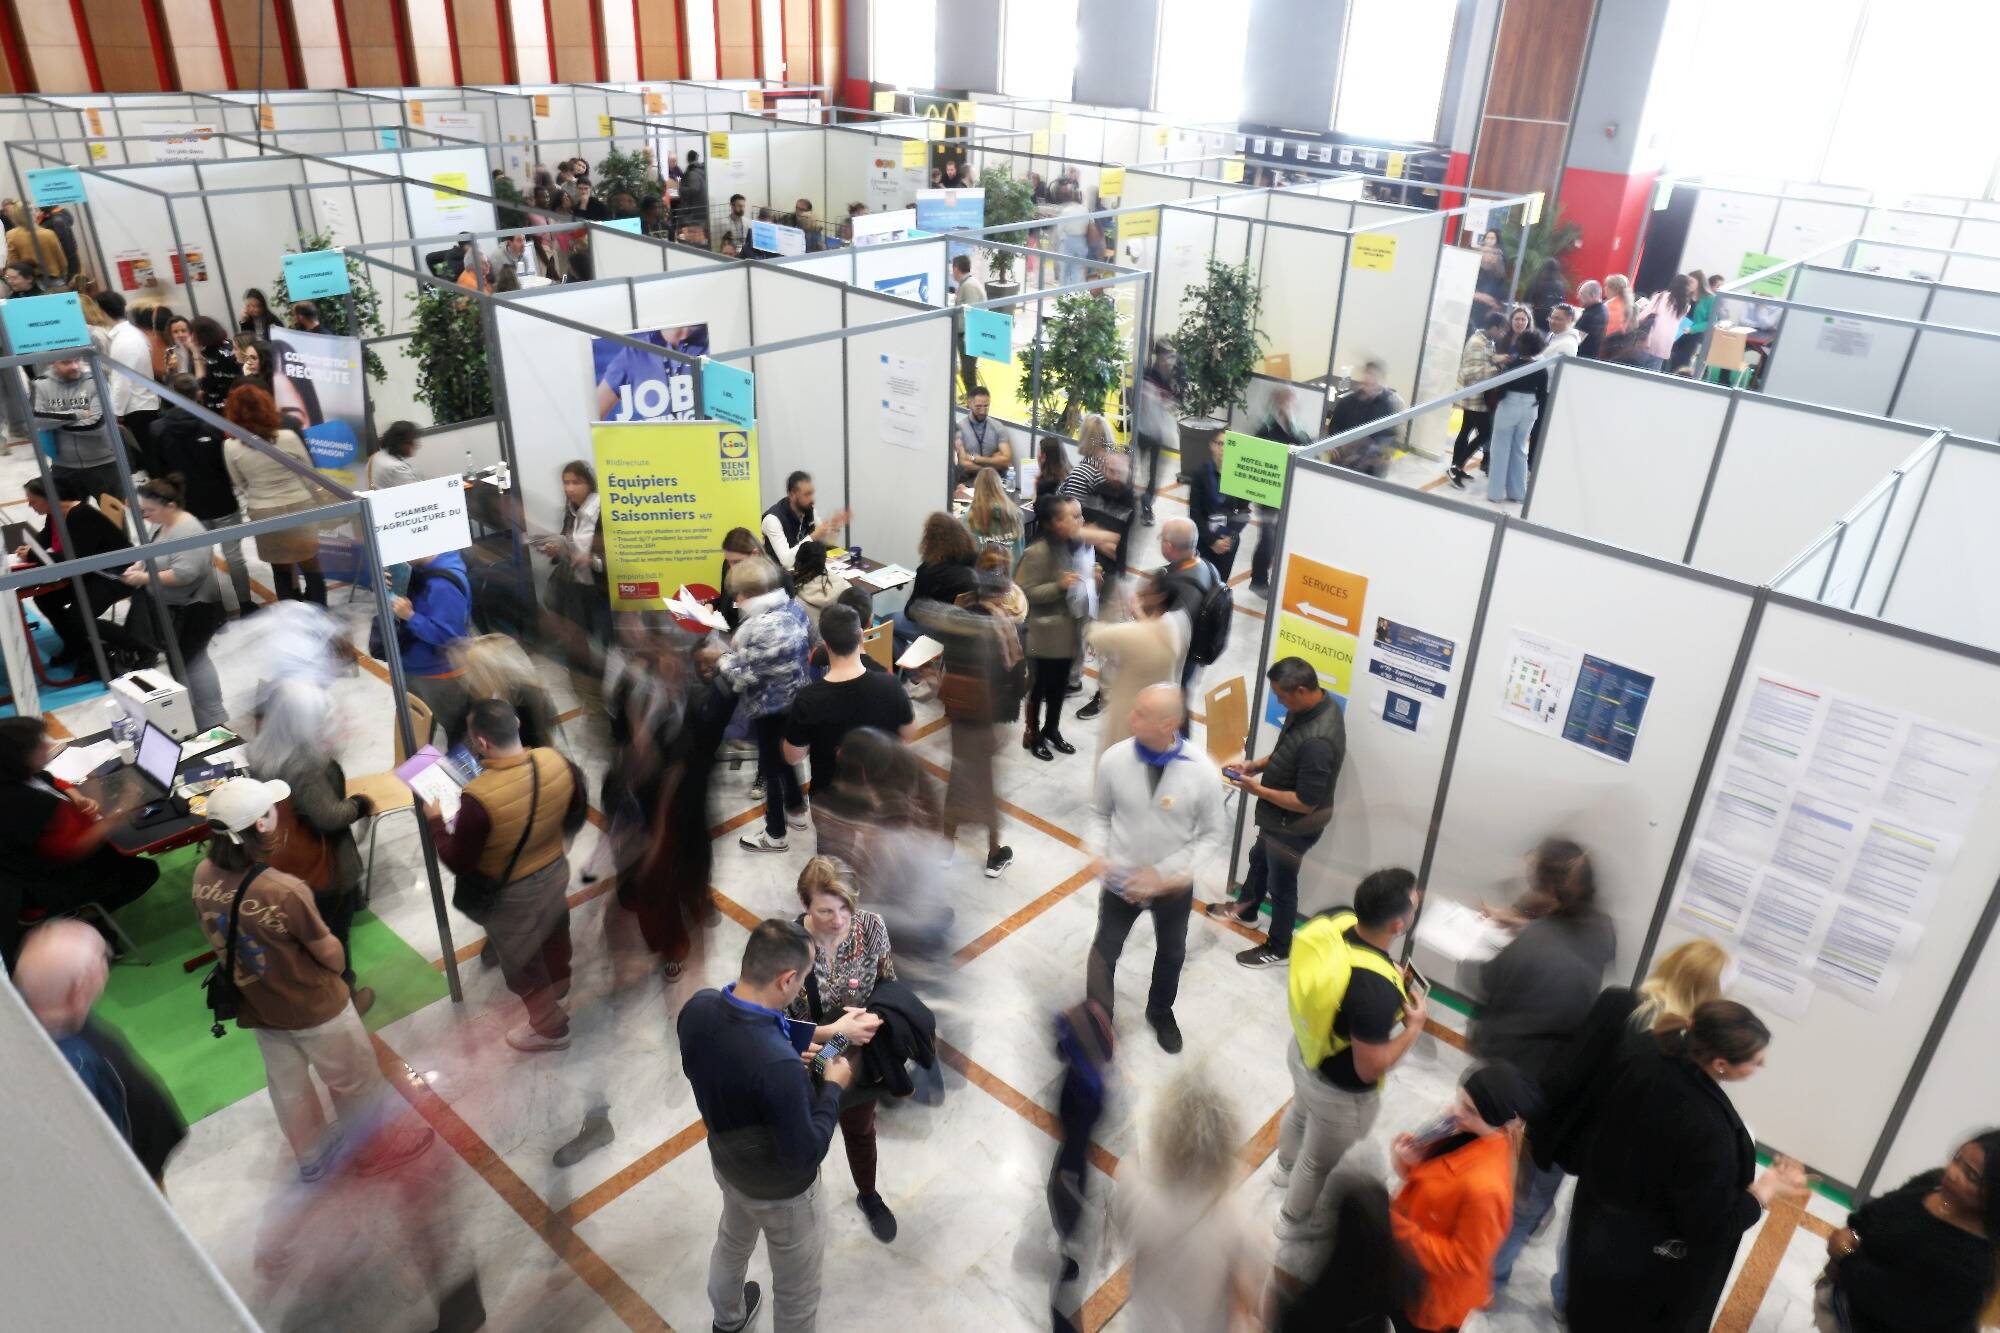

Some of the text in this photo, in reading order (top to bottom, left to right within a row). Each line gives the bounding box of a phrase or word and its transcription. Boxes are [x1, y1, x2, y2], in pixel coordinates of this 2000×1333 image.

[285, 363, 351, 385] RECRUTE
[616, 374, 695, 421] JOB
[1237, 463, 1281, 479] RESTAURANT
[448, 480, 459, 488] 69
[608, 473, 678, 490] Équipiers
[1248, 474, 1282, 488] PALMIERS
[609, 492, 697, 507] Polyvalents
[394, 503, 439, 519] CHAMBRE
[449, 507, 461, 516] DU
[611, 508, 695, 521] Saisonniers
[411, 525, 429, 534] VAR
[1302, 575, 1349, 600] SERVICES
[1280, 629, 1353, 664] RESTAURATION
